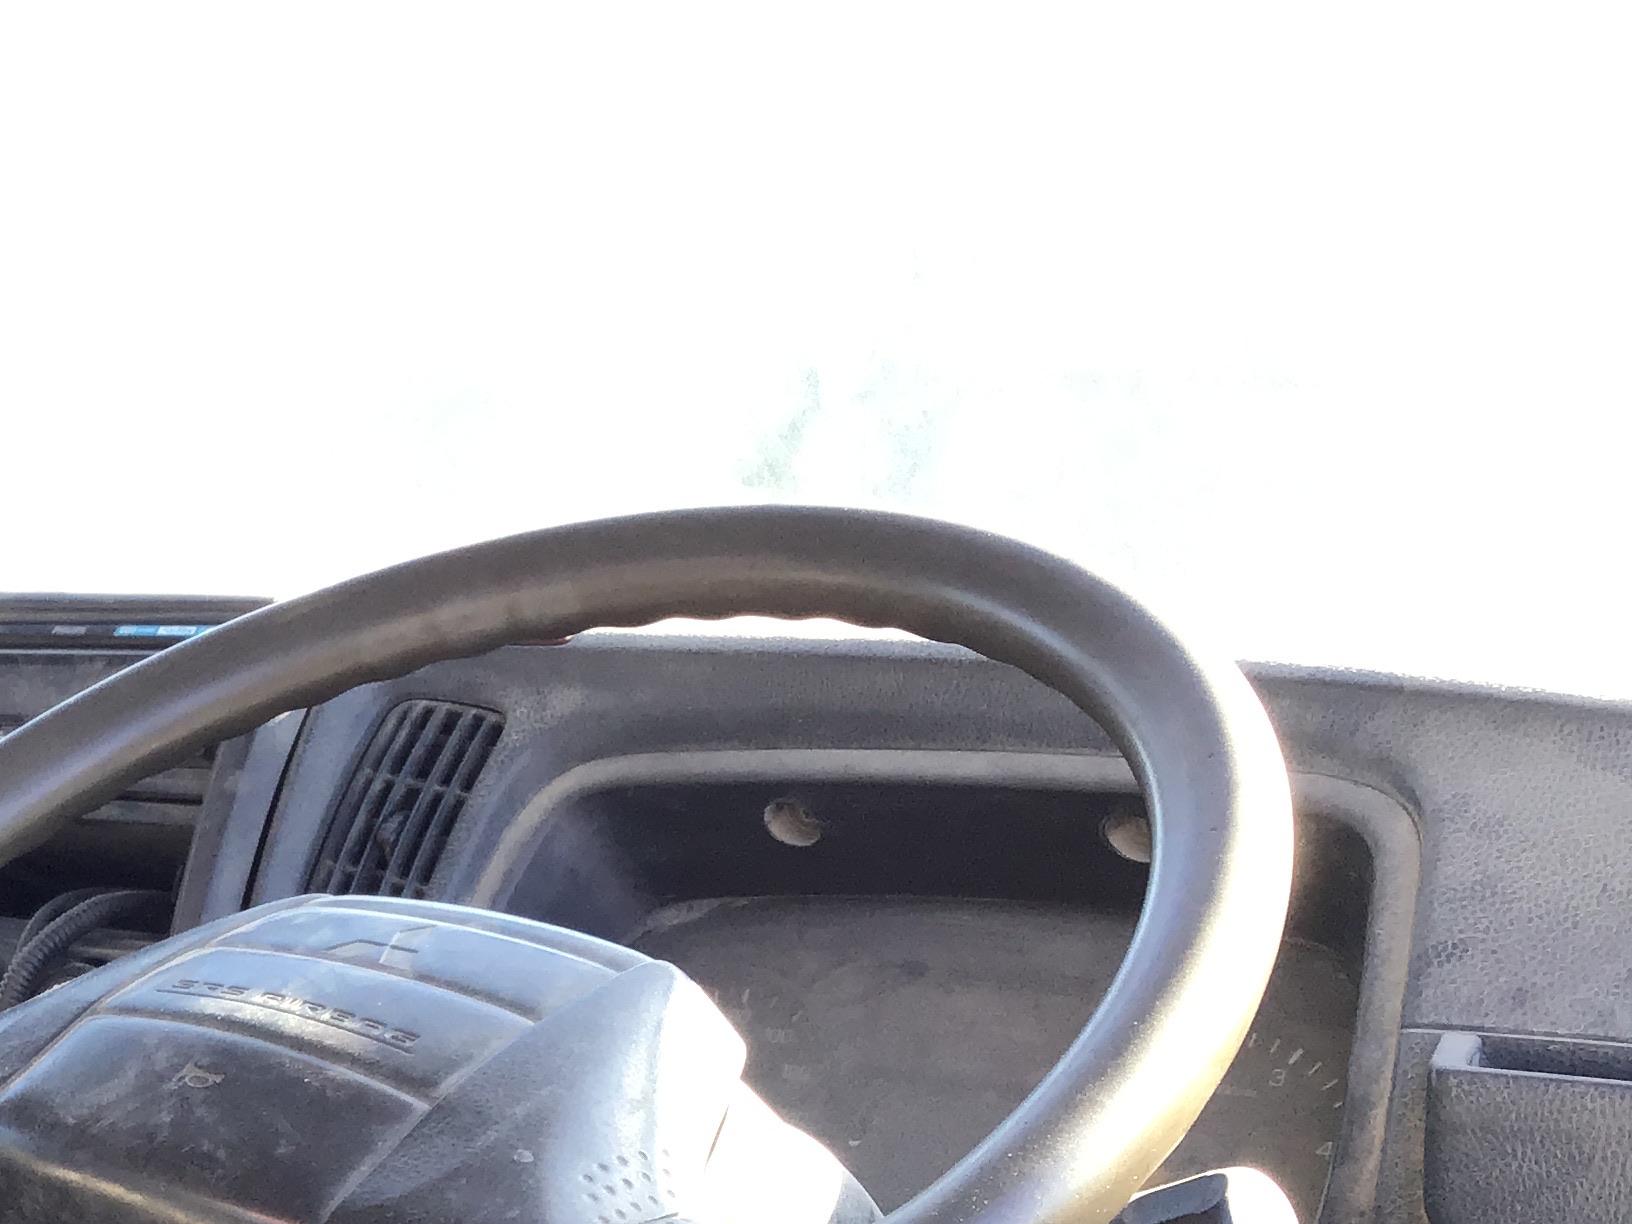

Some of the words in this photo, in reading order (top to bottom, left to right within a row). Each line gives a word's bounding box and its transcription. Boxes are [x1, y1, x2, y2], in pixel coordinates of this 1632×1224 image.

[172, 979, 250, 996] SRS
[259, 991, 421, 1043] AIRBAG
[1268, 1068, 1286, 1087] 3
